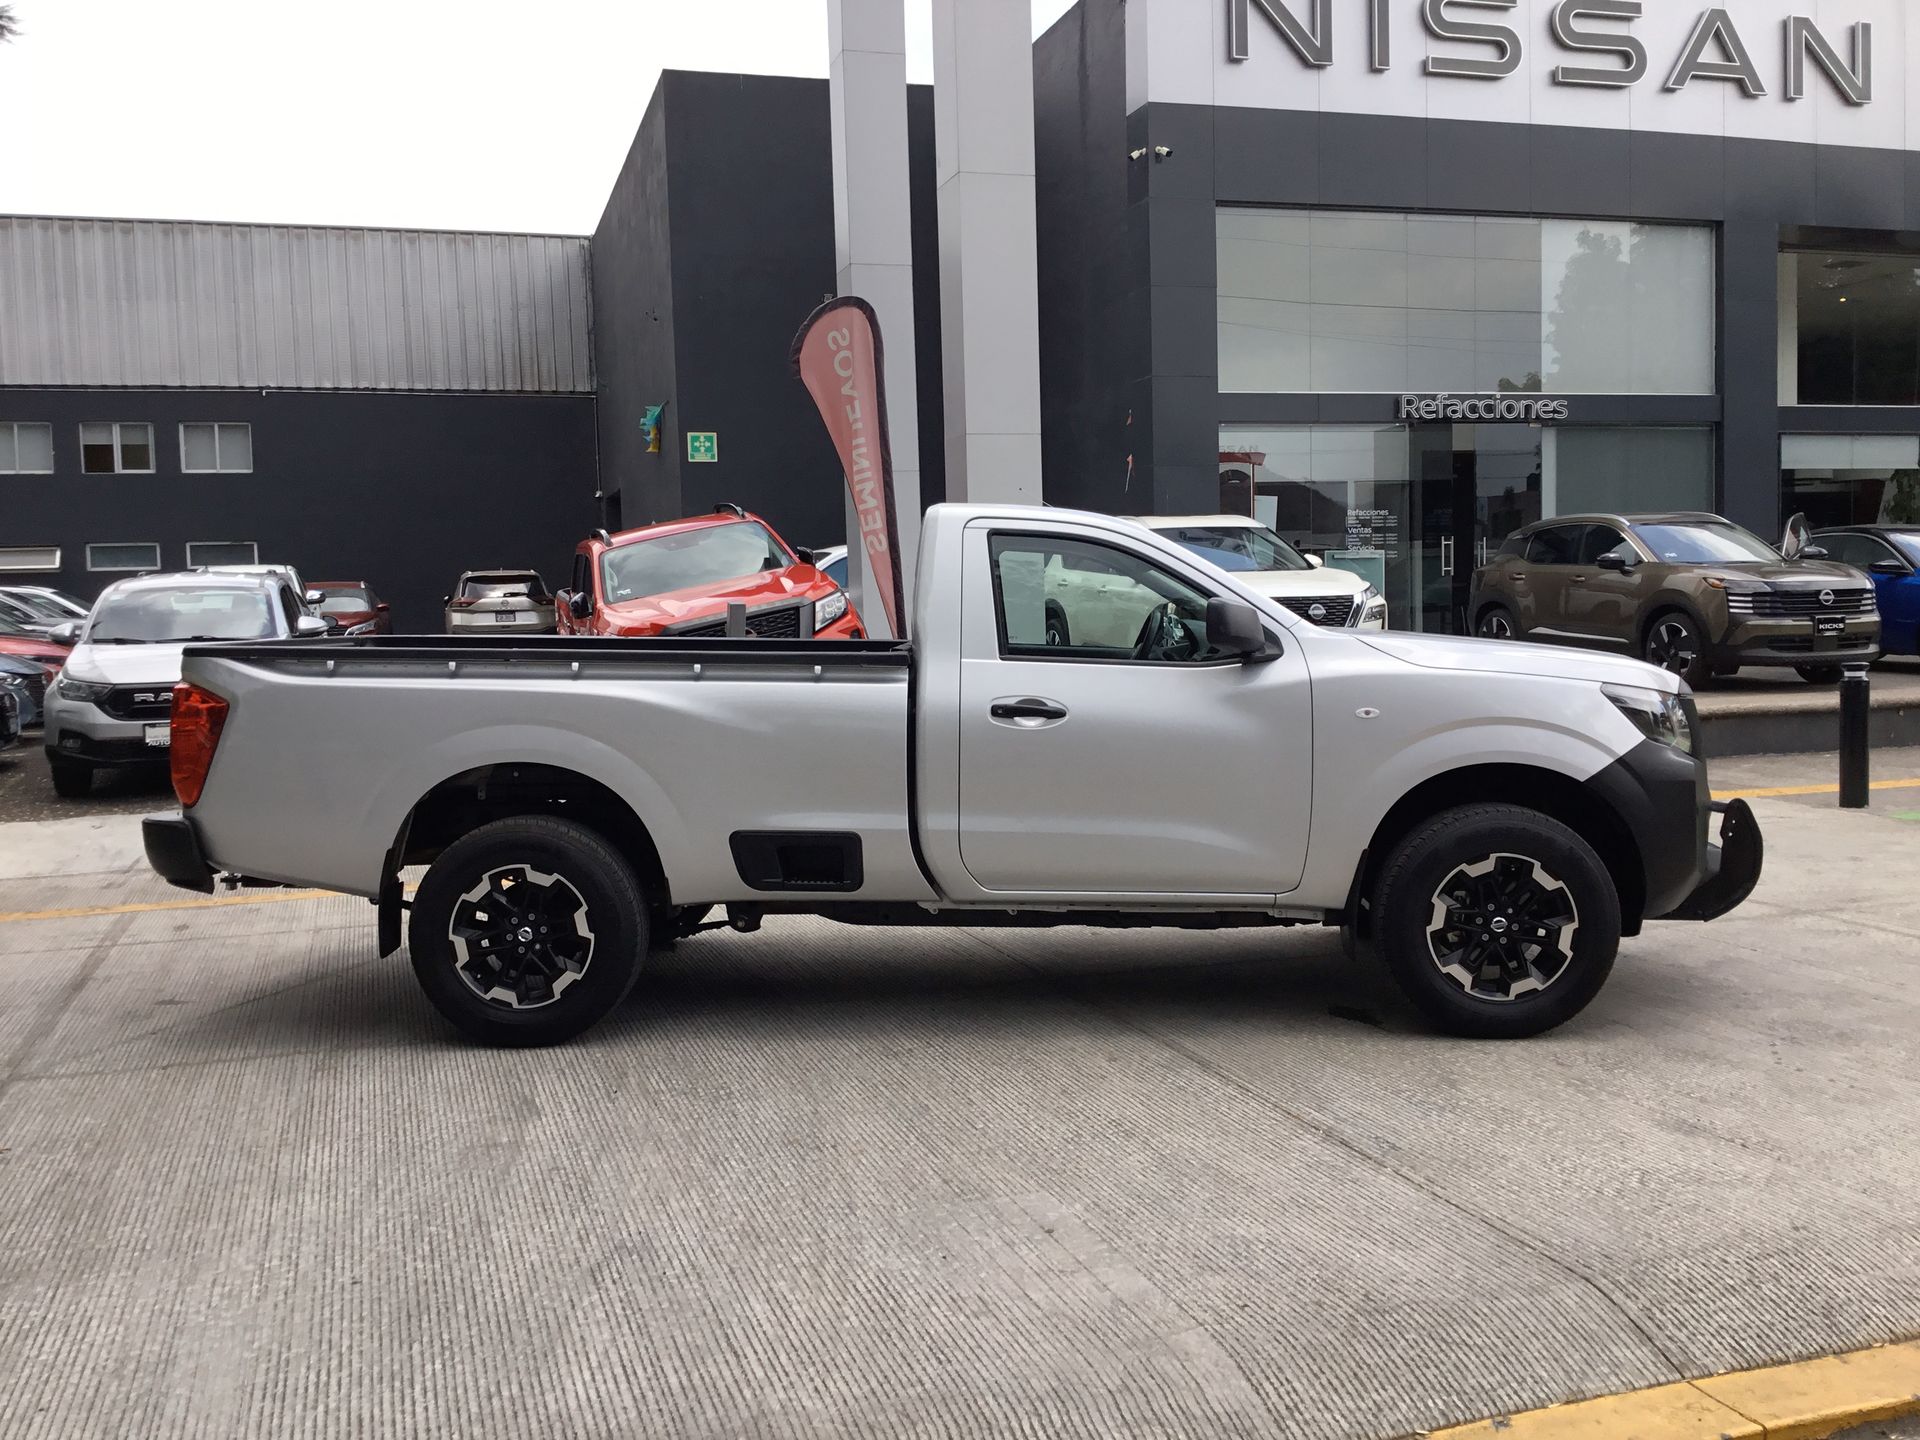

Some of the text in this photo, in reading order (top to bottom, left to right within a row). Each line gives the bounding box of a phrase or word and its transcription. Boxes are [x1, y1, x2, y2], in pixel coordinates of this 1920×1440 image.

[1228, 0, 1873, 104] NISSAN
[1400, 393, 1569, 419] Refacciones
[133, 692, 174, 702] RA
